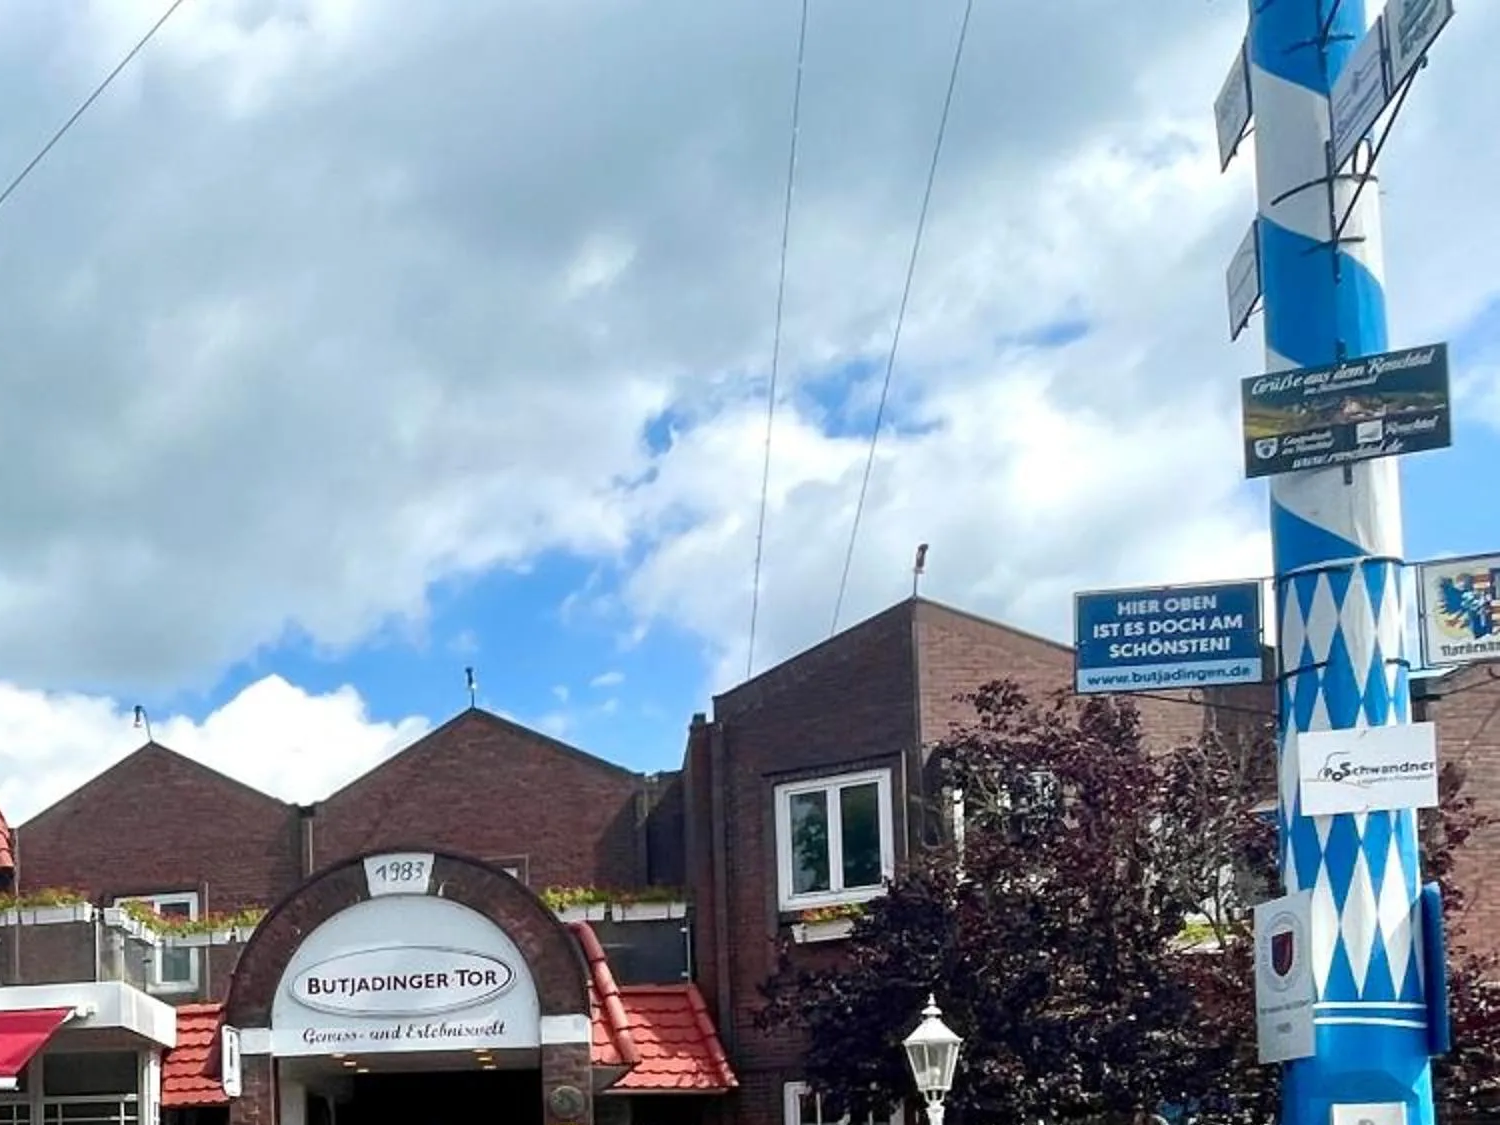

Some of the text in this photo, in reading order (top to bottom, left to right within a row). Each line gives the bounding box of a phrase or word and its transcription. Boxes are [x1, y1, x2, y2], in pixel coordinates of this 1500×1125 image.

[1117, 594, 1217, 616] HIER OBEN
[1093, 614, 1243, 639] IST ES DOCH AM
[1109, 636, 1231, 659] SCHÖNSTEN!
[1087, 664, 1251, 686] www.butjadingen.de
[375, 860, 425, 881] 1983
[307, 969, 498, 996] BUTJADINGER TOR
[369, 1024, 401, 1041] und
[405, 1020, 506, 1040] Erlebniswelt
